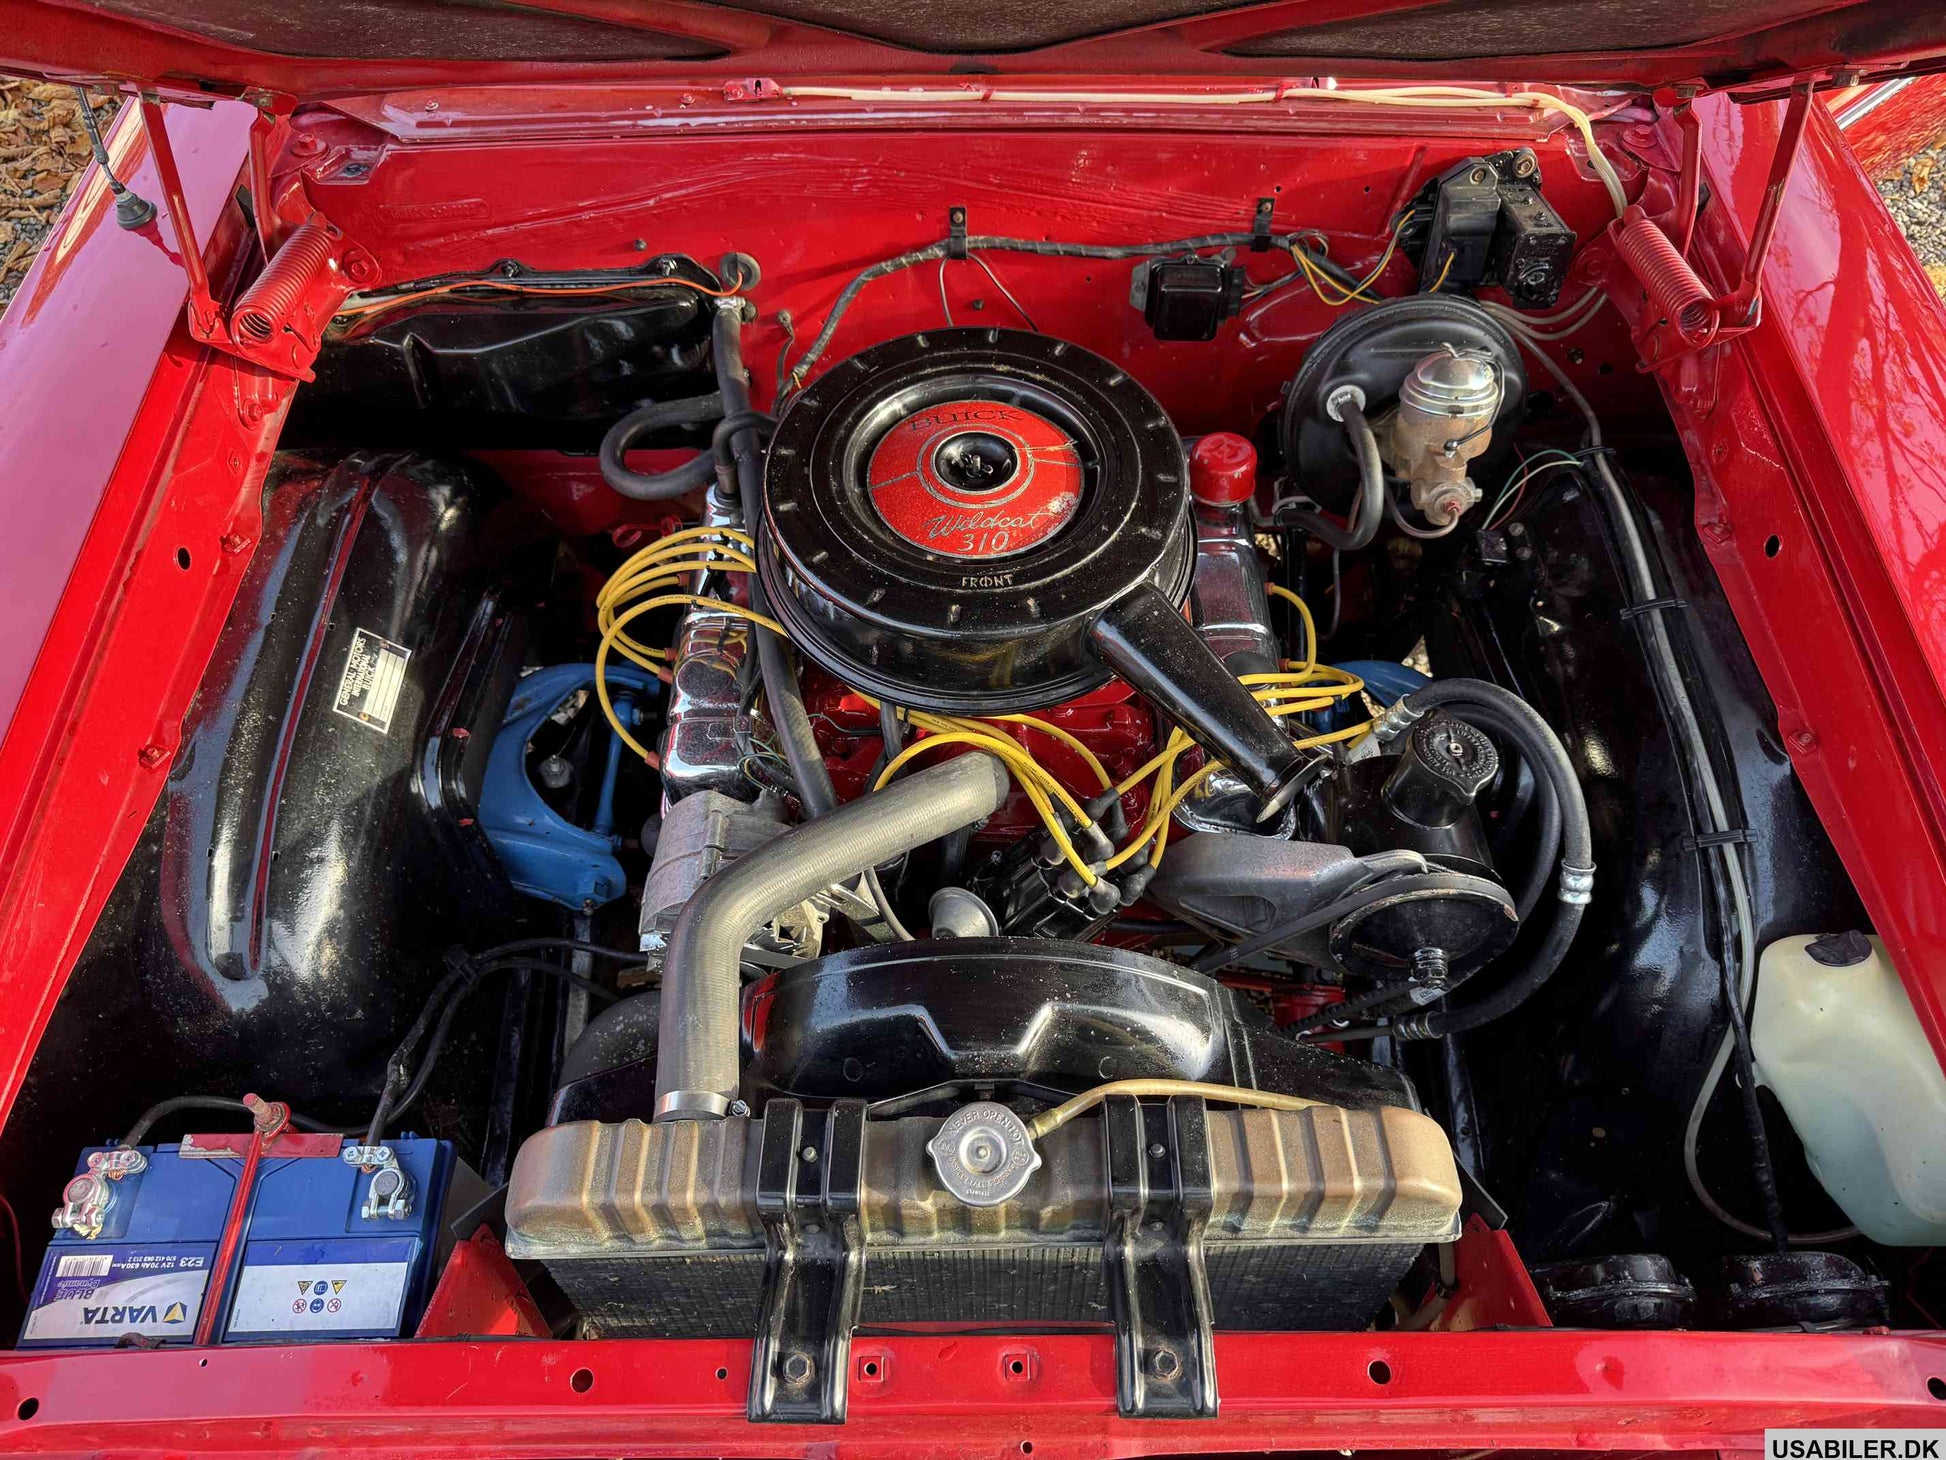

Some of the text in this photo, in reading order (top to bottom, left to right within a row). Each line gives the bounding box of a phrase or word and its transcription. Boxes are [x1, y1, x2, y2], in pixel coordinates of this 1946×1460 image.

[909, 410, 1023, 431] BUICK
[923, 509, 1051, 539] Wildcat
[958, 531, 1010, 552] 310
[961, 574, 1014, 587] FRONT
[340, 637, 367, 706] GENERAL MOTORS
[362, 666, 376, 690] BUICK
[949, 1110, 979, 1135] NEVER
[983, 1109, 1011, 1128] OPEN
[179, 1256, 205, 1267] E23
[55, 1288, 95, 1300] BLUE
[82, 1305, 157, 1324] VARTA
